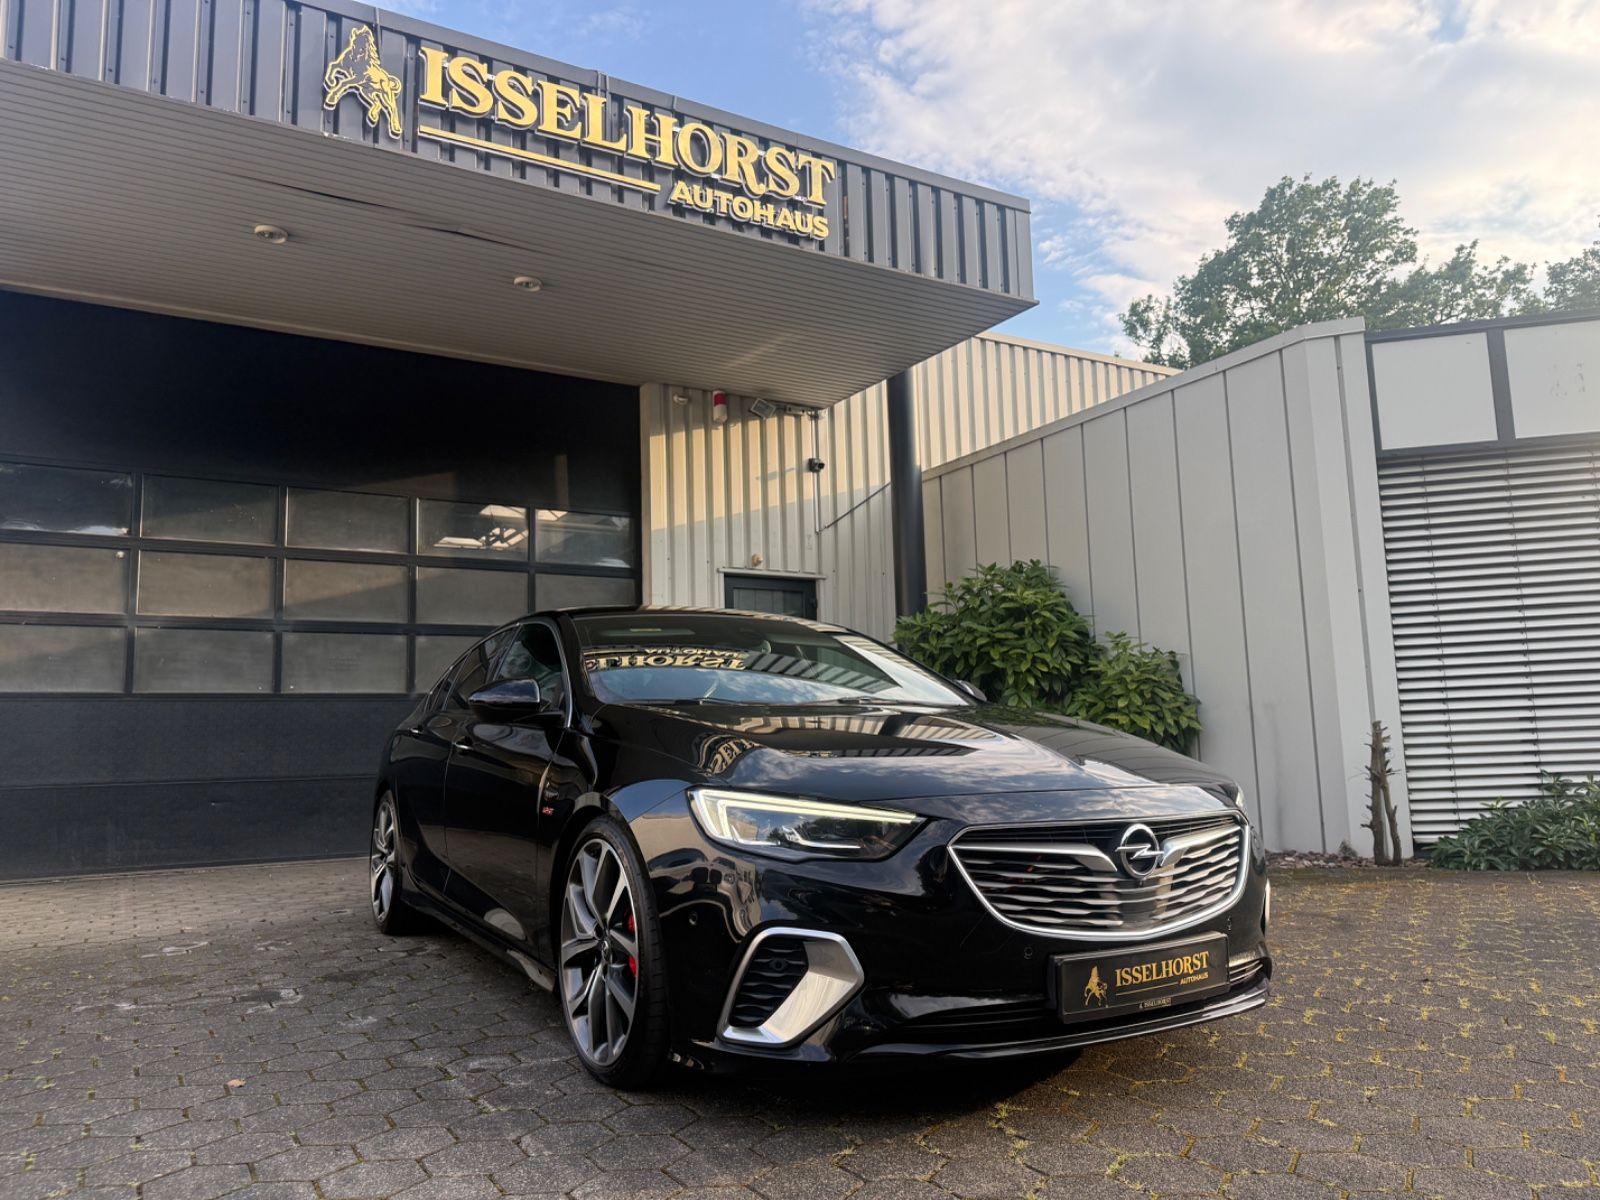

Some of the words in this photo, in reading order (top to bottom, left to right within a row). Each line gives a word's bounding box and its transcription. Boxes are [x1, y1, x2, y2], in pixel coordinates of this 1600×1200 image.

[419, 45, 836, 208] ISSELHORST
[669, 179, 830, 240] AUTOHAUS
[1114, 950, 1210, 987] ISSELHORST
[1179, 972, 1209, 986] AUTOHAUS
